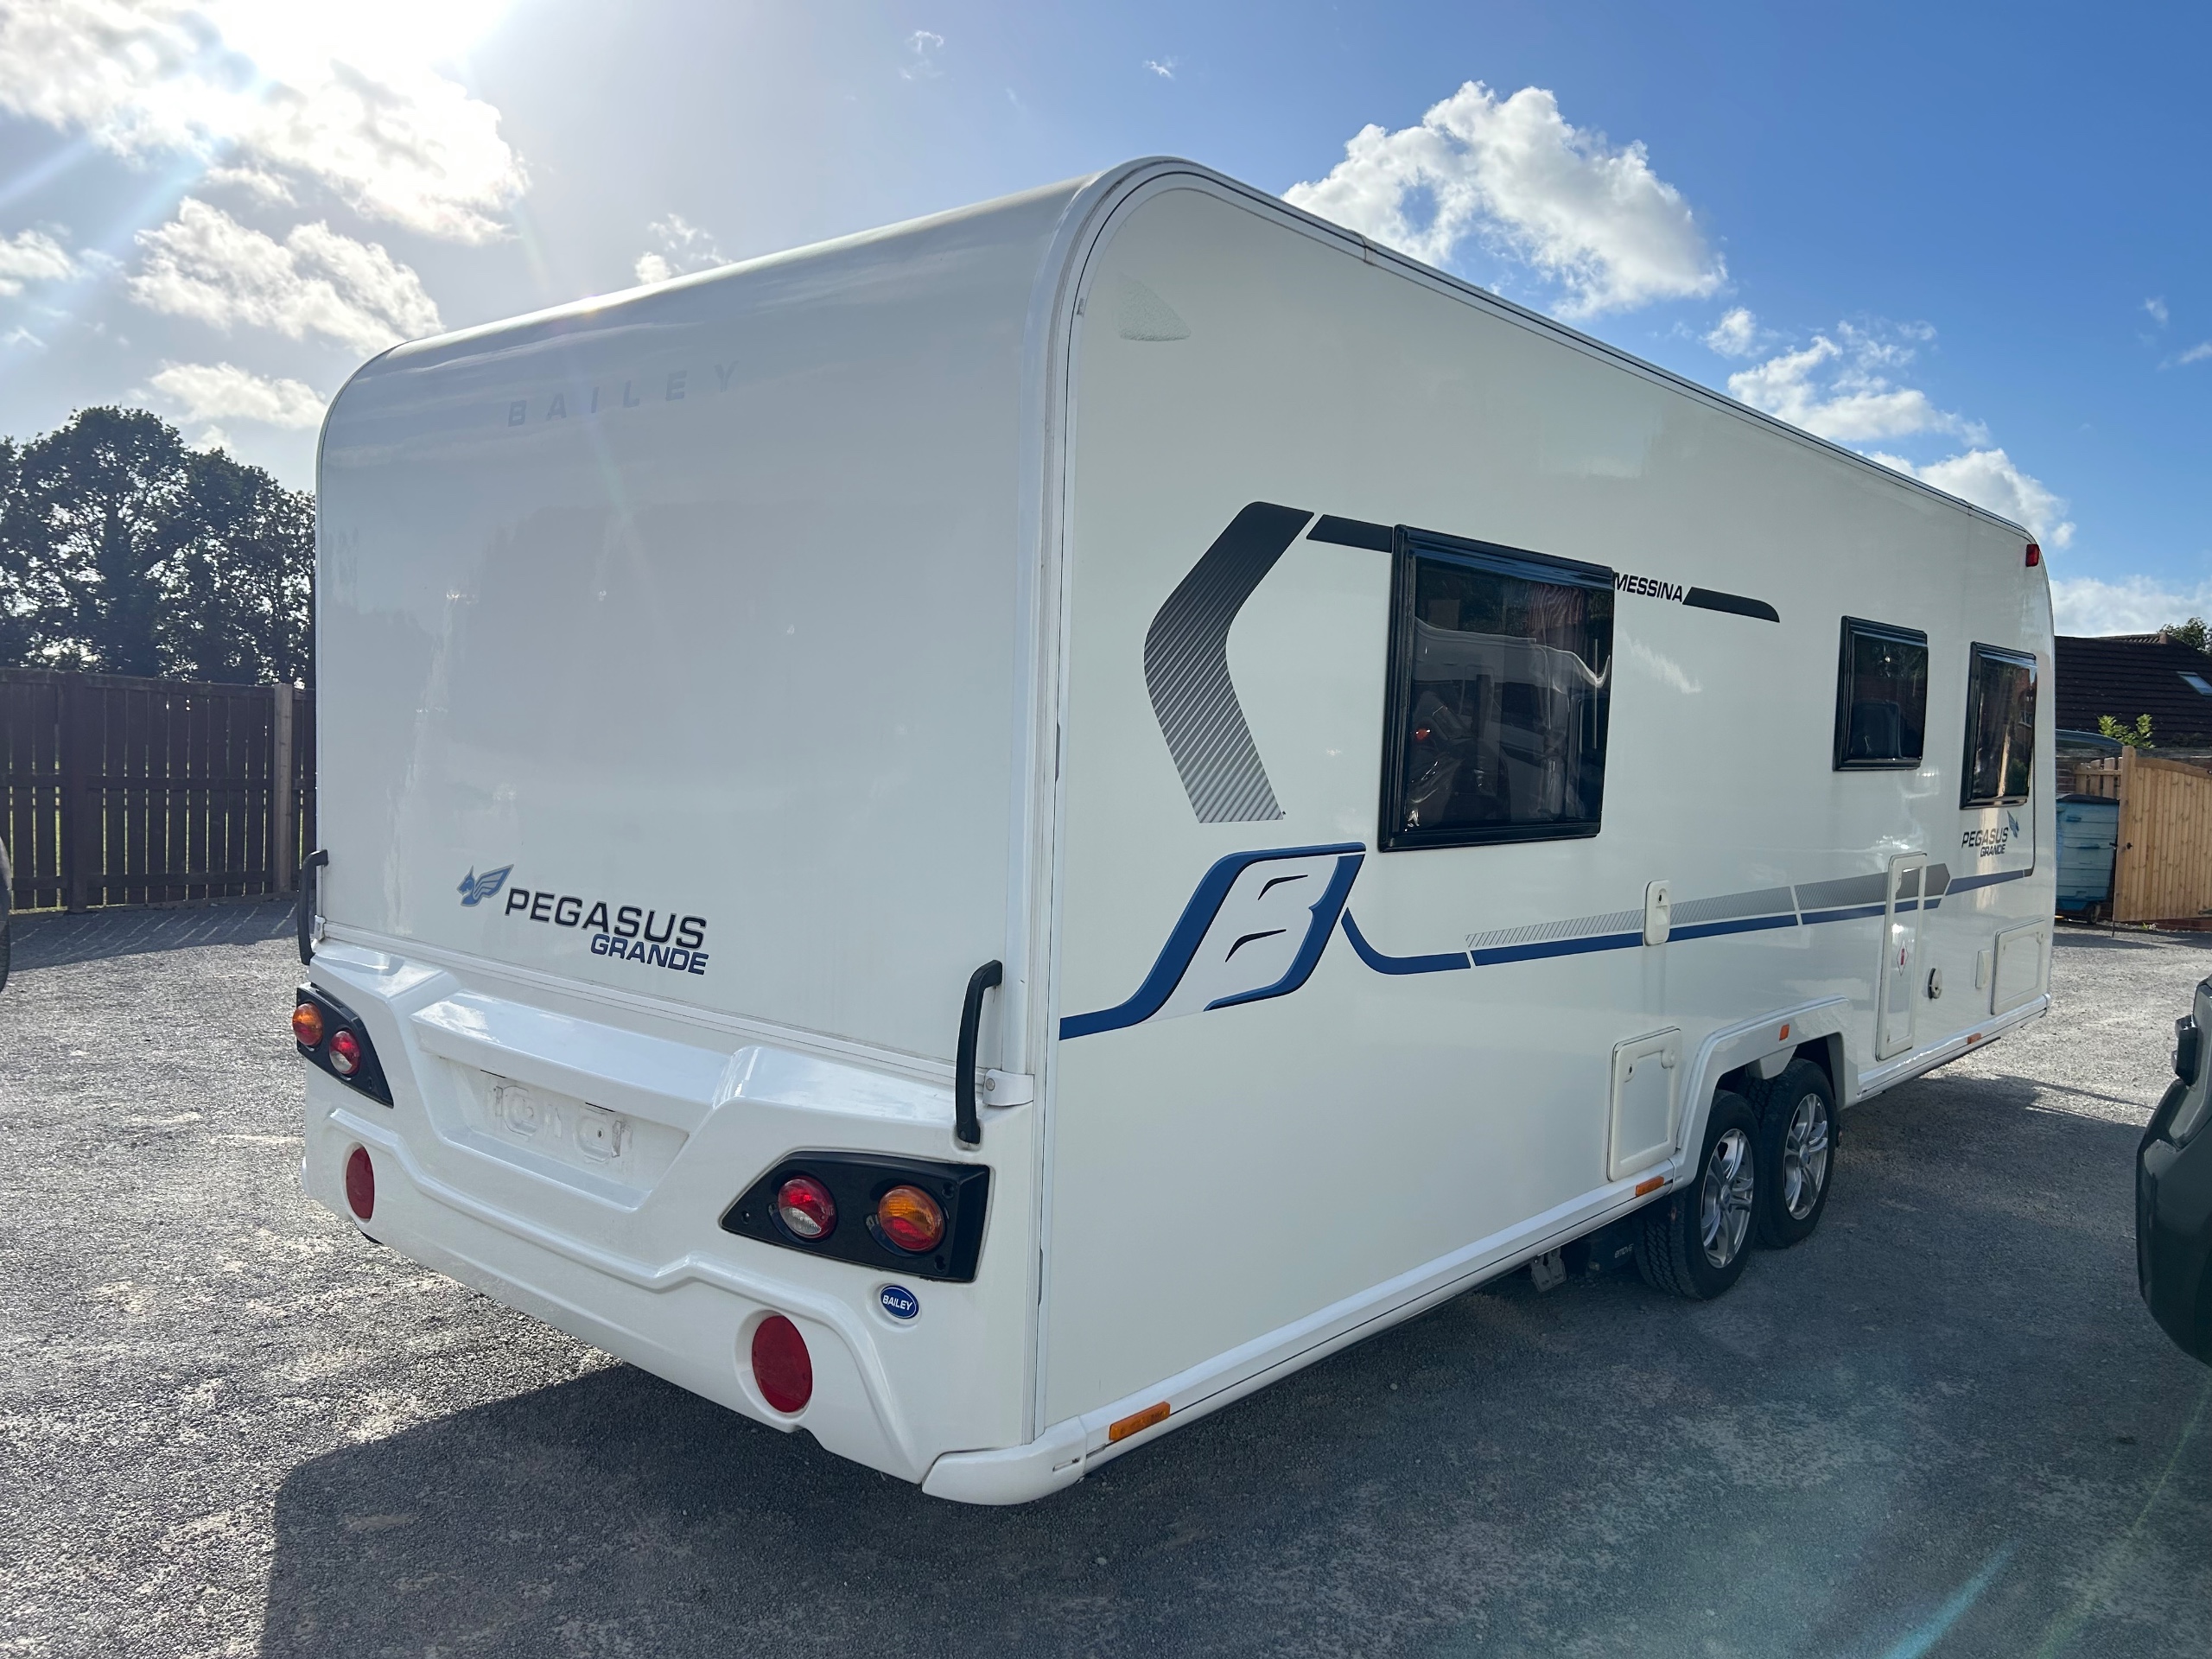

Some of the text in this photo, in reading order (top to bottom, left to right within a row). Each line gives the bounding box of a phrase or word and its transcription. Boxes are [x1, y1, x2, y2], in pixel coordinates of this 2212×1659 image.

[507, 360, 739, 427] BAILEY
[1614, 572, 1682, 602] MESSINA
[1961, 827, 2009, 849] PEGASUS
[1980, 844, 2005, 857] GRANDE
[505, 887, 707, 950] PEGASUS
[590, 933, 709, 976] GRANDE
[882, 1294, 912, 1311] BAILEY
